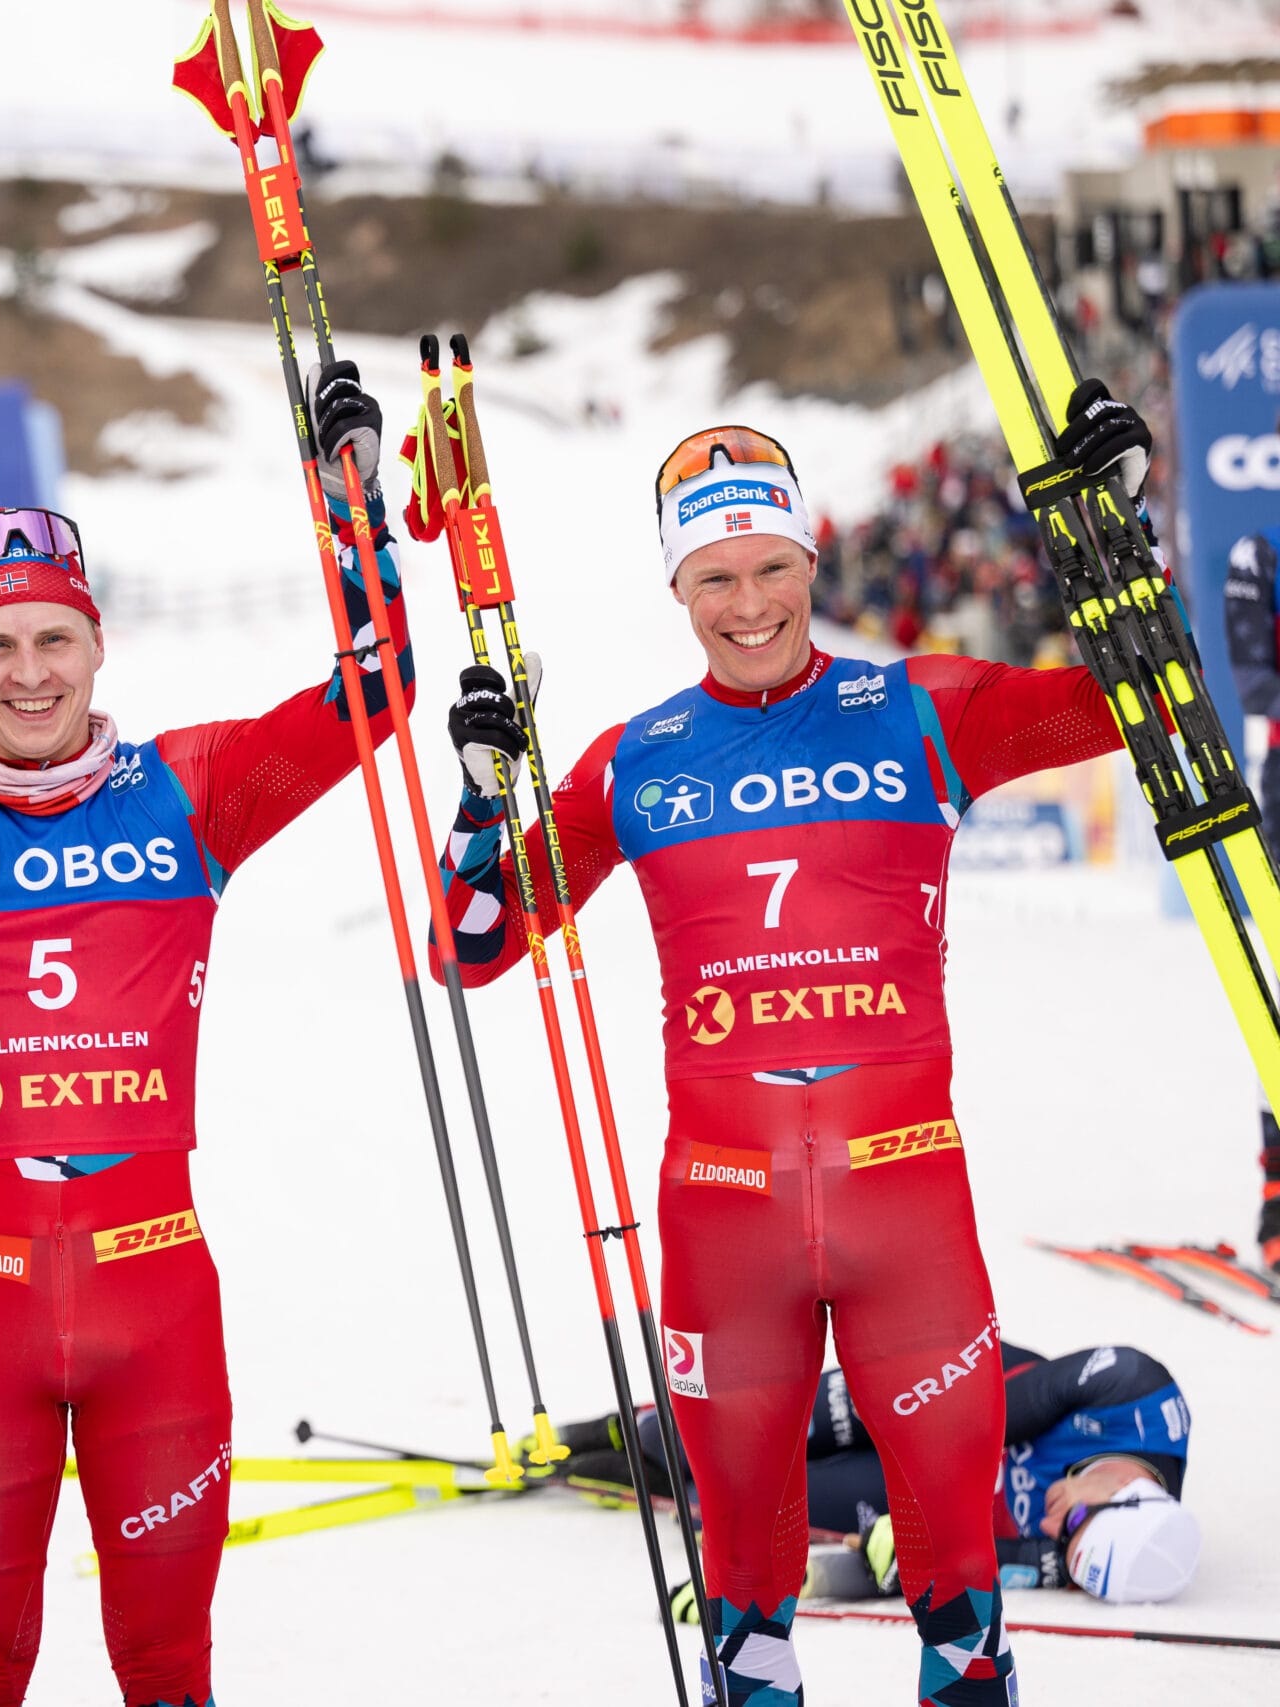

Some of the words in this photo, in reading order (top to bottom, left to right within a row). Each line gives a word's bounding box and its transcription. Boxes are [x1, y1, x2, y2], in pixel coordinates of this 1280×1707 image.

[260, 173, 290, 250] LEKI
[264, 260, 280, 285] KI
[301, 248, 315, 272] KI
[680, 485, 769, 520] SpareBank
[773, 491, 783, 504] 1
[1025, 468, 1083, 497] FISC
[471, 513, 501, 595] LEKI
[841, 692, 885, 706] coop
[730, 760, 907, 813] OBOS
[1166, 803, 1250, 846] FISCHER
[13, 837, 179, 891] OBOS
[746, 859, 799, 929] 7
[920, 883, 938, 928] 7
[27, 938, 78, 1010] 5
[700, 946, 880, 979] HOLMENKOLLEN
[188, 960, 206, 1009] 5
[750, 982, 907, 1025] EXTRA
[20, 1068, 168, 1109] EXTRA
[868, 1125, 953, 1160] DHL
[689, 1161, 766, 1189] ELDORADO
[113, 1217, 193, 1255] DHL
[670, 1375, 704, 1396] aplay
[892, 1328, 994, 1416] CRAFT
[120, 1457, 221, 1540] CRAFT
